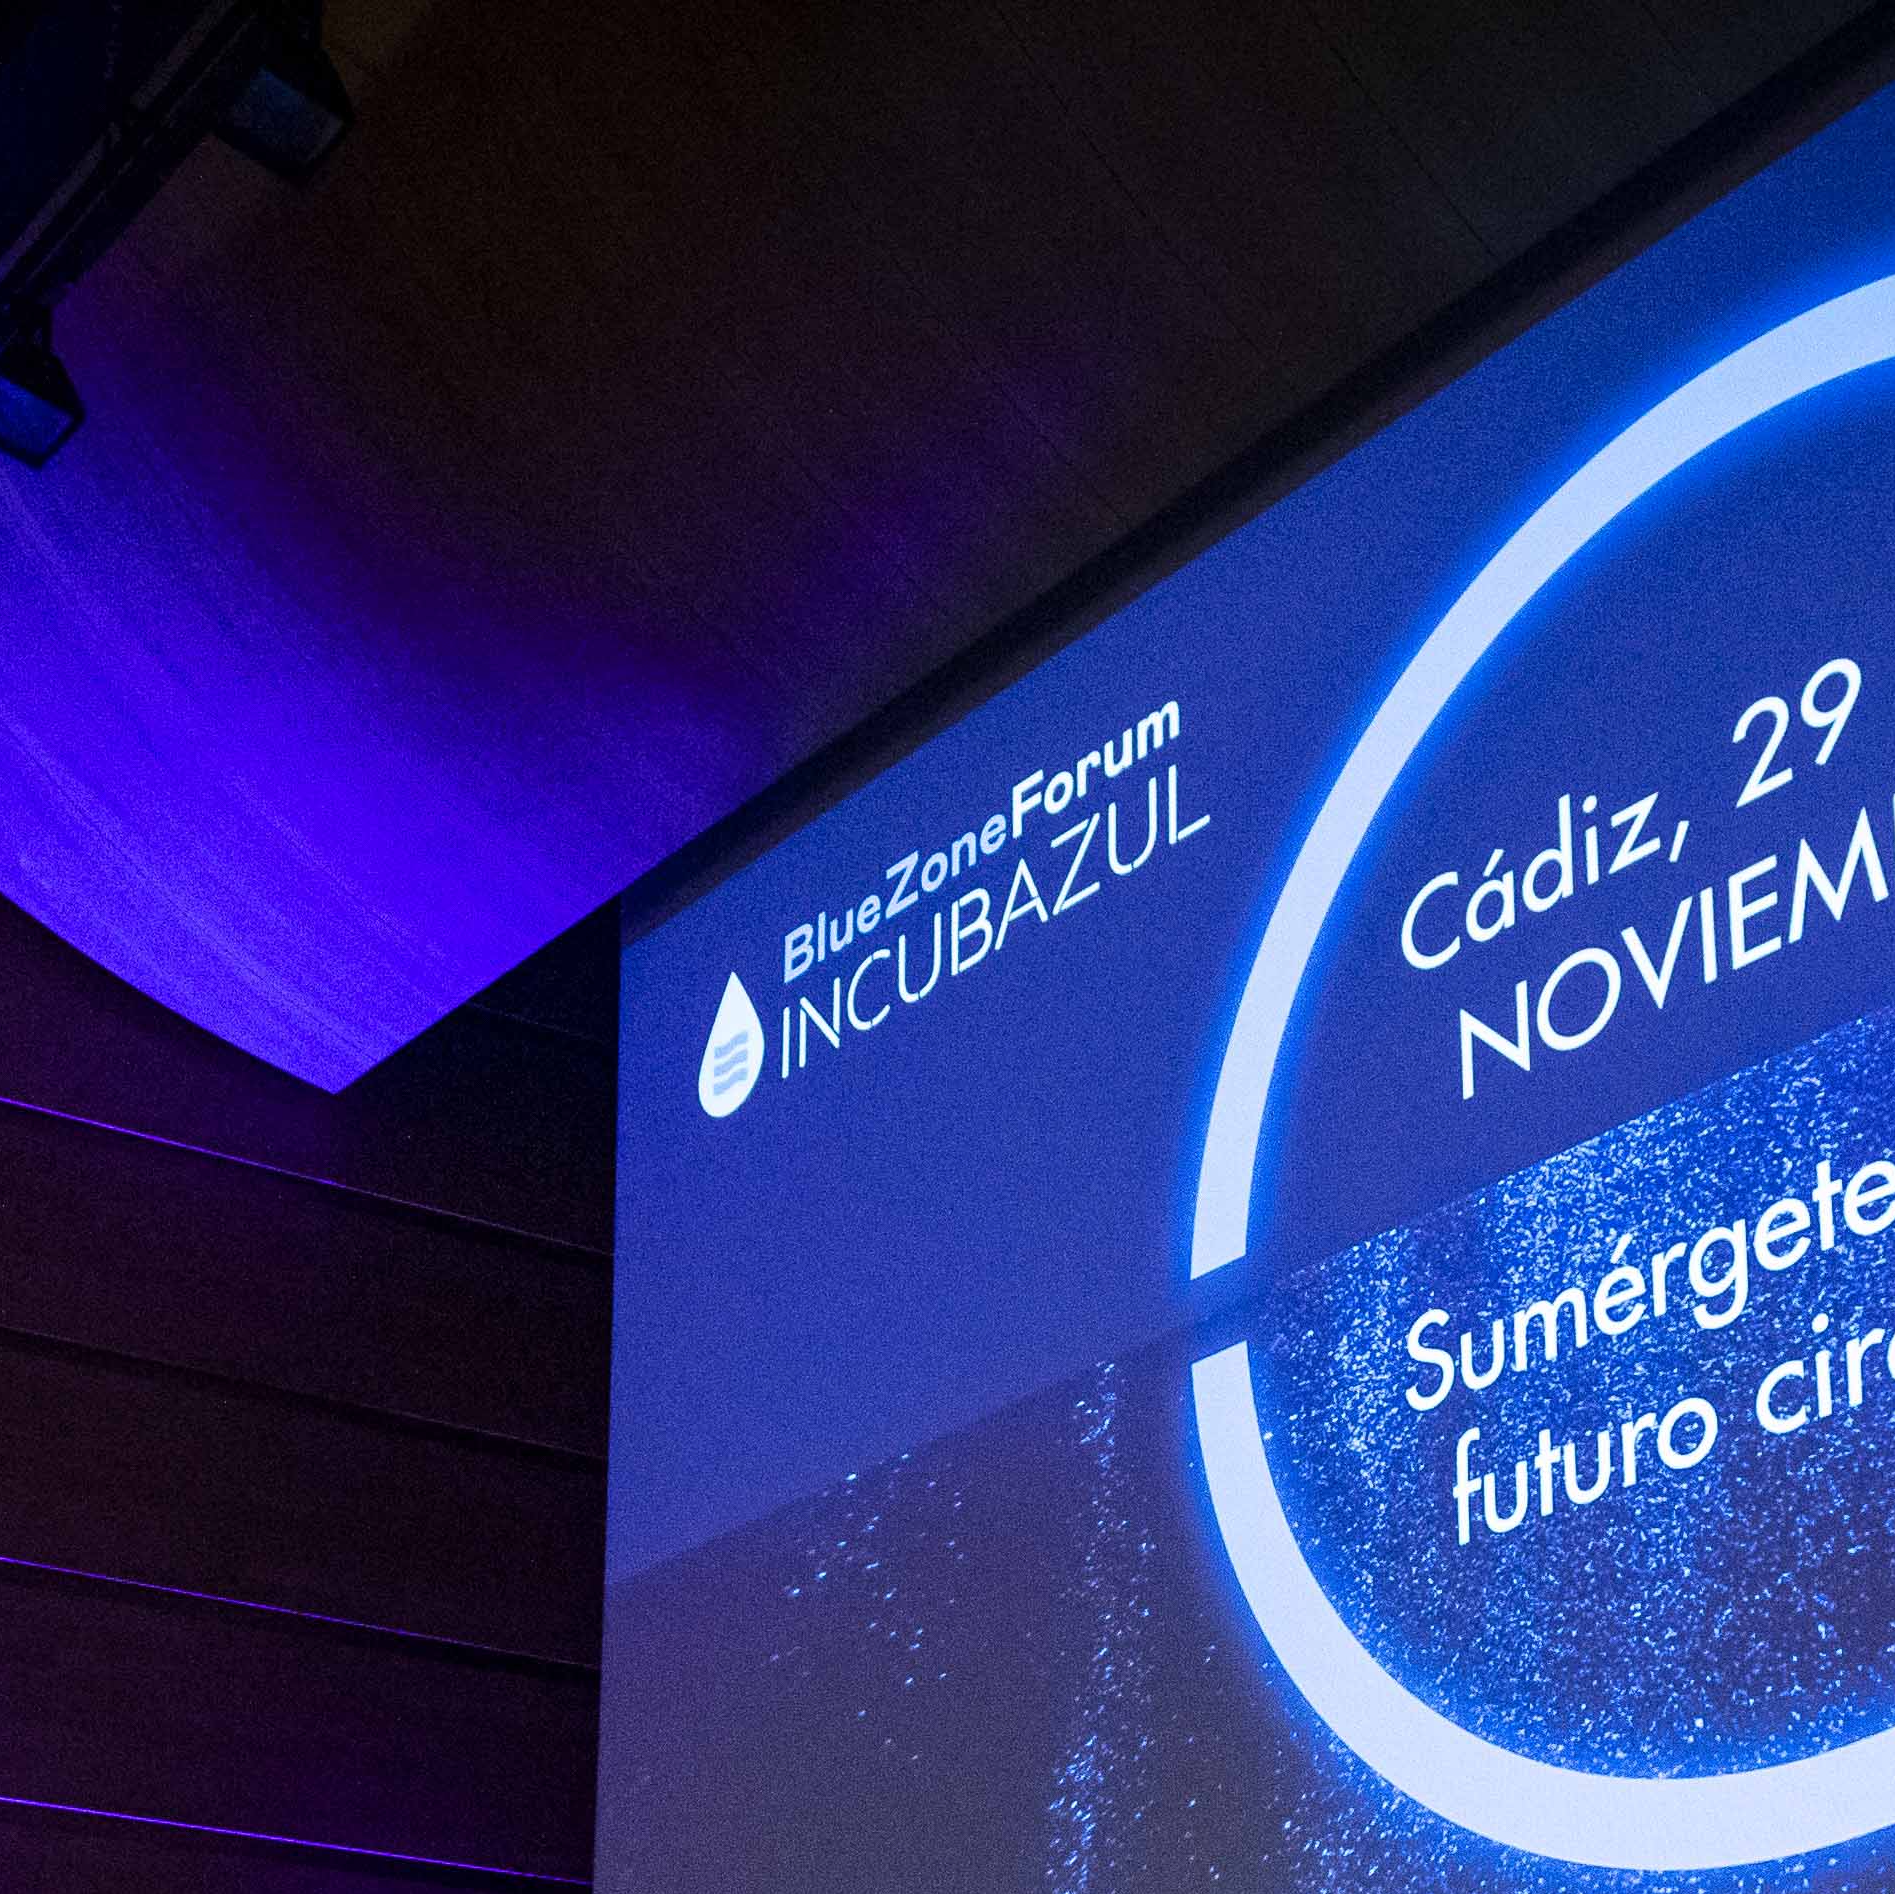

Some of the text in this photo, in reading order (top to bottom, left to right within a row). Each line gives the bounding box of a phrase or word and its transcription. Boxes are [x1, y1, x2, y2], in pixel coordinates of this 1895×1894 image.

[781, 764, 1210, 1078] INCUBAZUL
[782, 700, 1180, 983] BlueZoneForum
[1399, 791, 1690, 969] Cádiz,
[1729, 658, 1862, 808] 29
[1453, 1397, 1718, 1546] futuro
